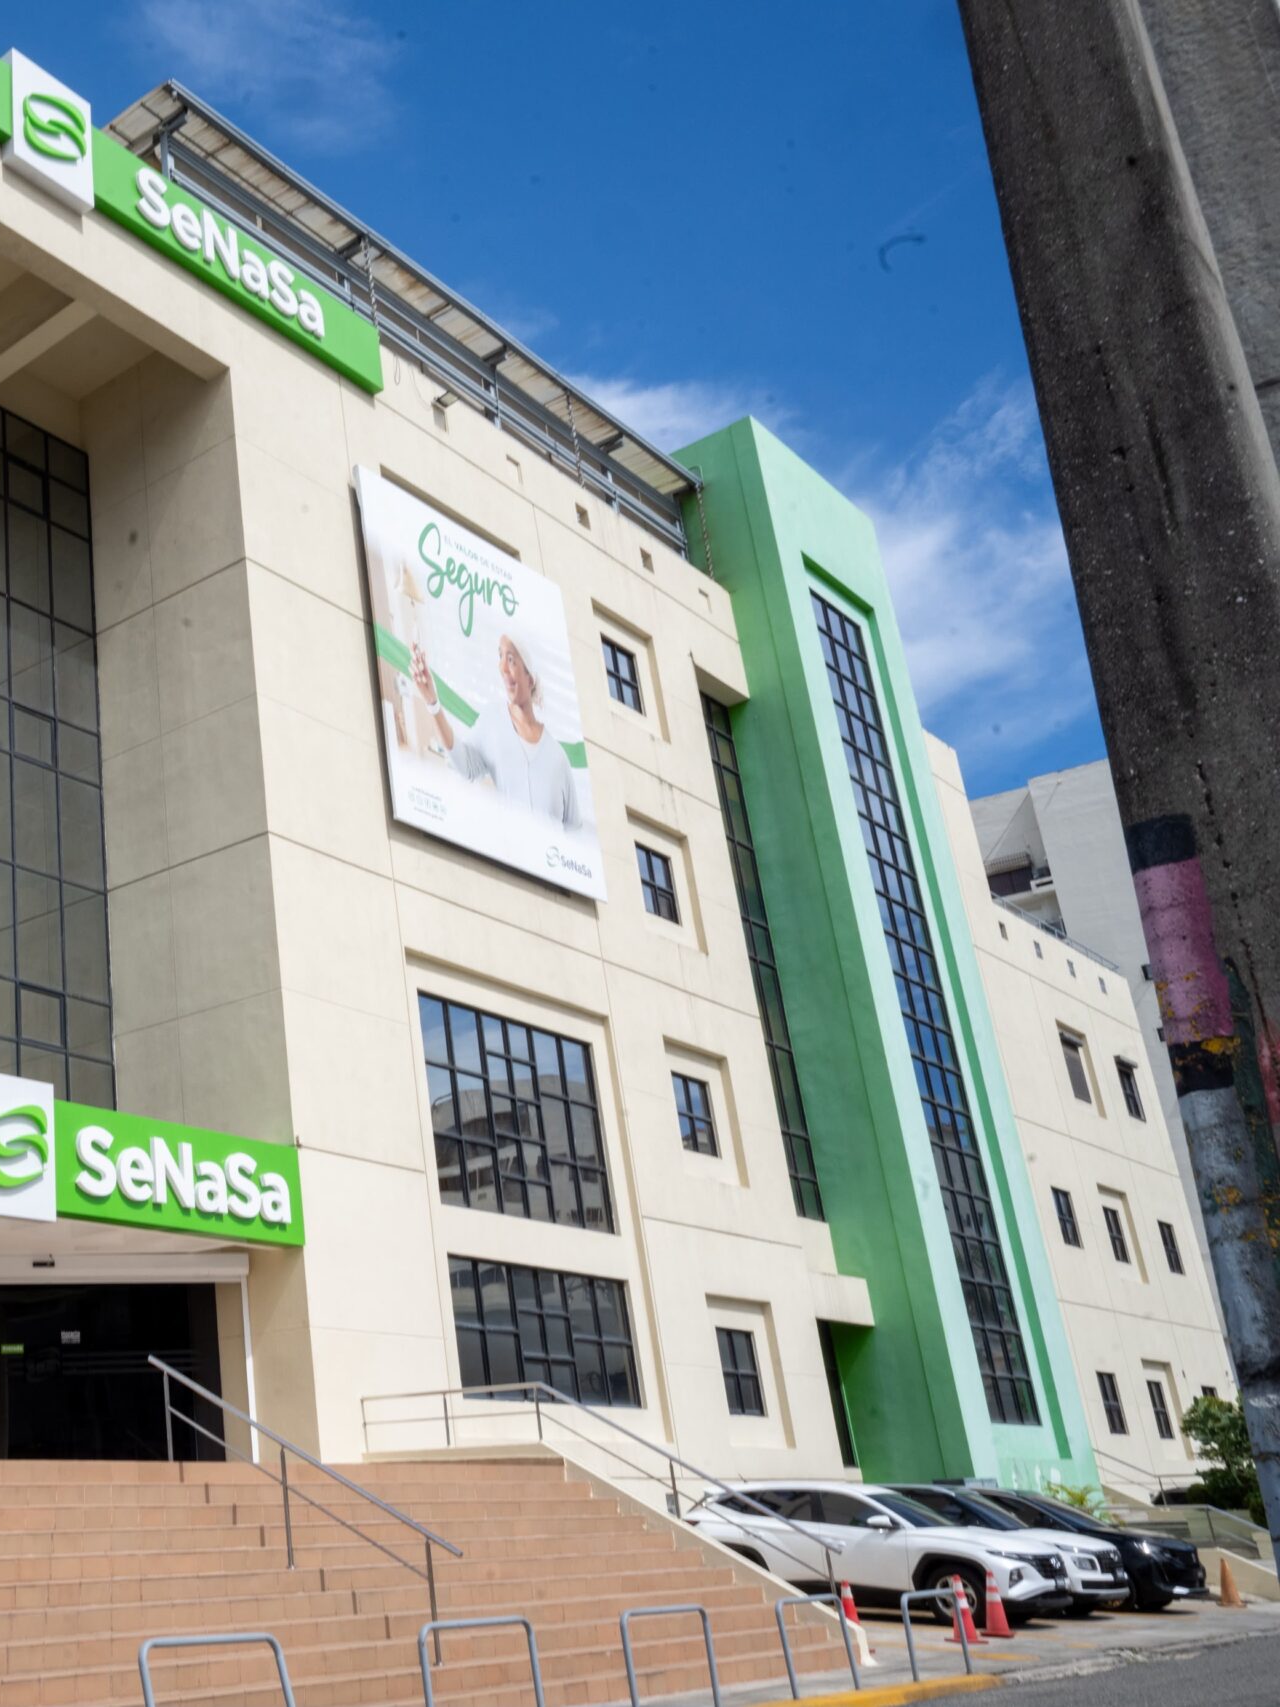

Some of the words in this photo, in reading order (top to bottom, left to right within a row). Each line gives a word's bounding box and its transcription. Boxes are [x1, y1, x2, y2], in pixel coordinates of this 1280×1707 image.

[136, 167, 325, 338] SeNaSa
[418, 522, 520, 638] Seguro
[560, 855, 593, 879] SeNaSa
[75, 1125, 292, 1224] SeNaSa
